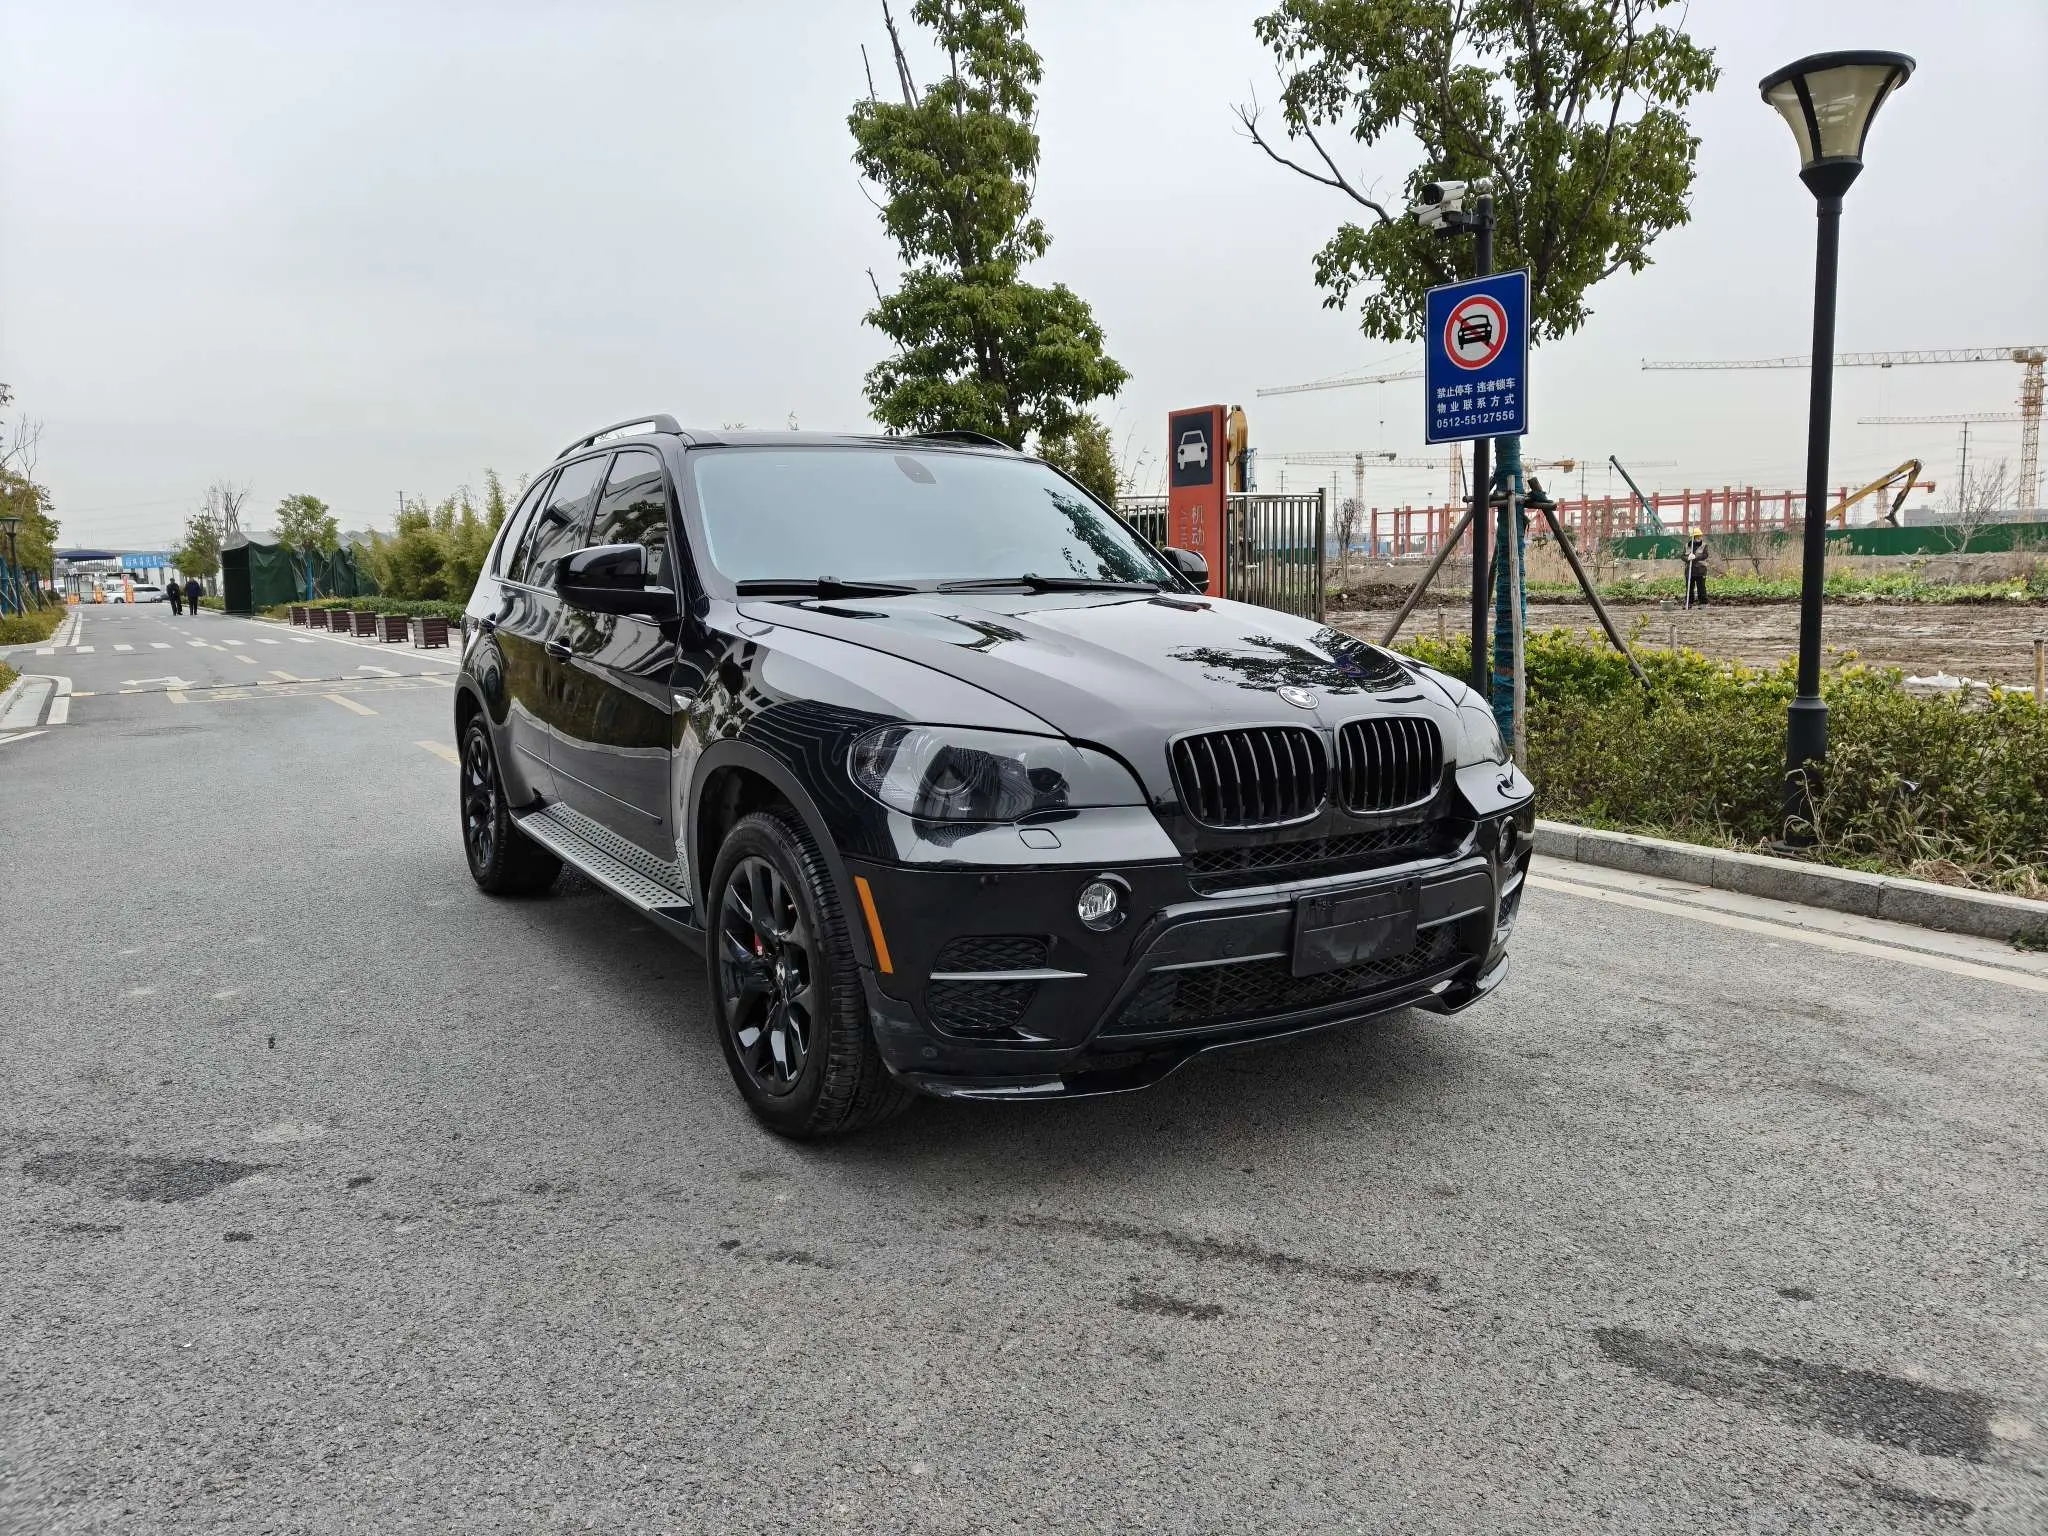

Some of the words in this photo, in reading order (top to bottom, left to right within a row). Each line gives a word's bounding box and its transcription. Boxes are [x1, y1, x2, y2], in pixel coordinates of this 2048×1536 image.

[1436, 384, 1473, 399] 禁止停车
[1477, 377, 1516, 393] 违者锁车
[1437, 393, 1515, 414] 物业联系方式
[1436, 410, 1515, 428] 0512-55127556
